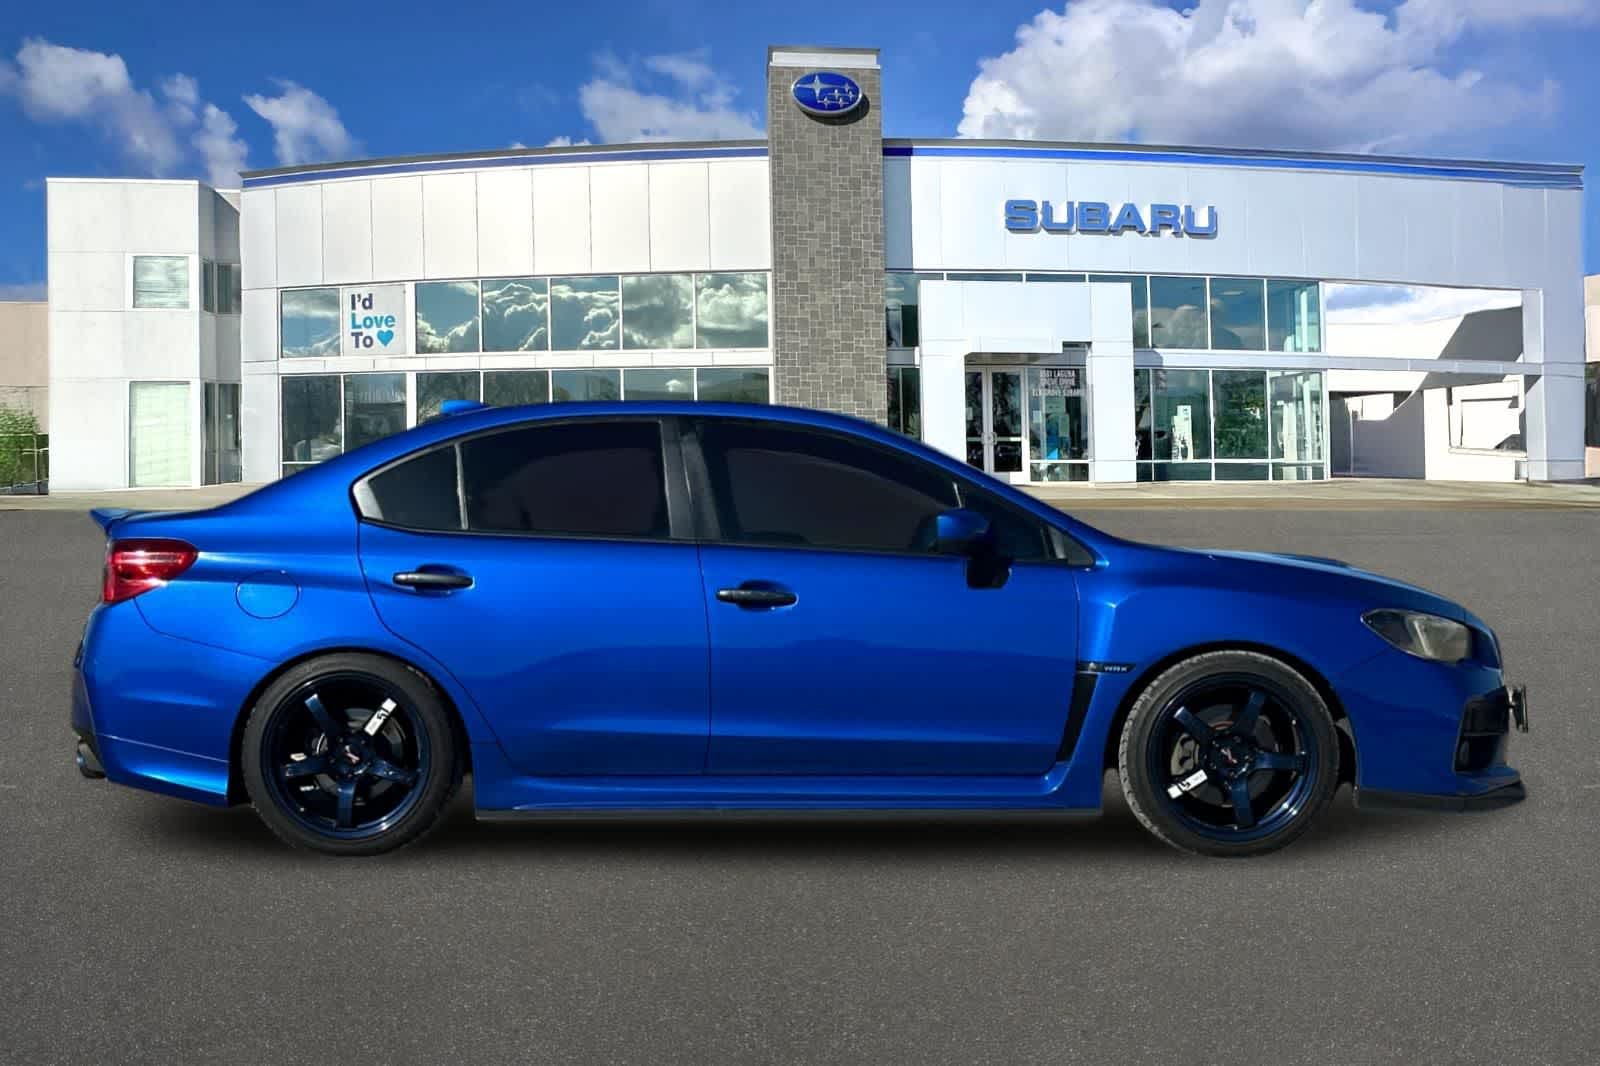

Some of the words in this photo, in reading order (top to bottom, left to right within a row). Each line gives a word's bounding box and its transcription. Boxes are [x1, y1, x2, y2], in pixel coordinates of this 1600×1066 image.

[1005, 199, 1218, 239] SUBARU
[351, 293, 373, 311] I'd
[351, 312, 396, 330] Love
[351, 331, 374, 349] To
